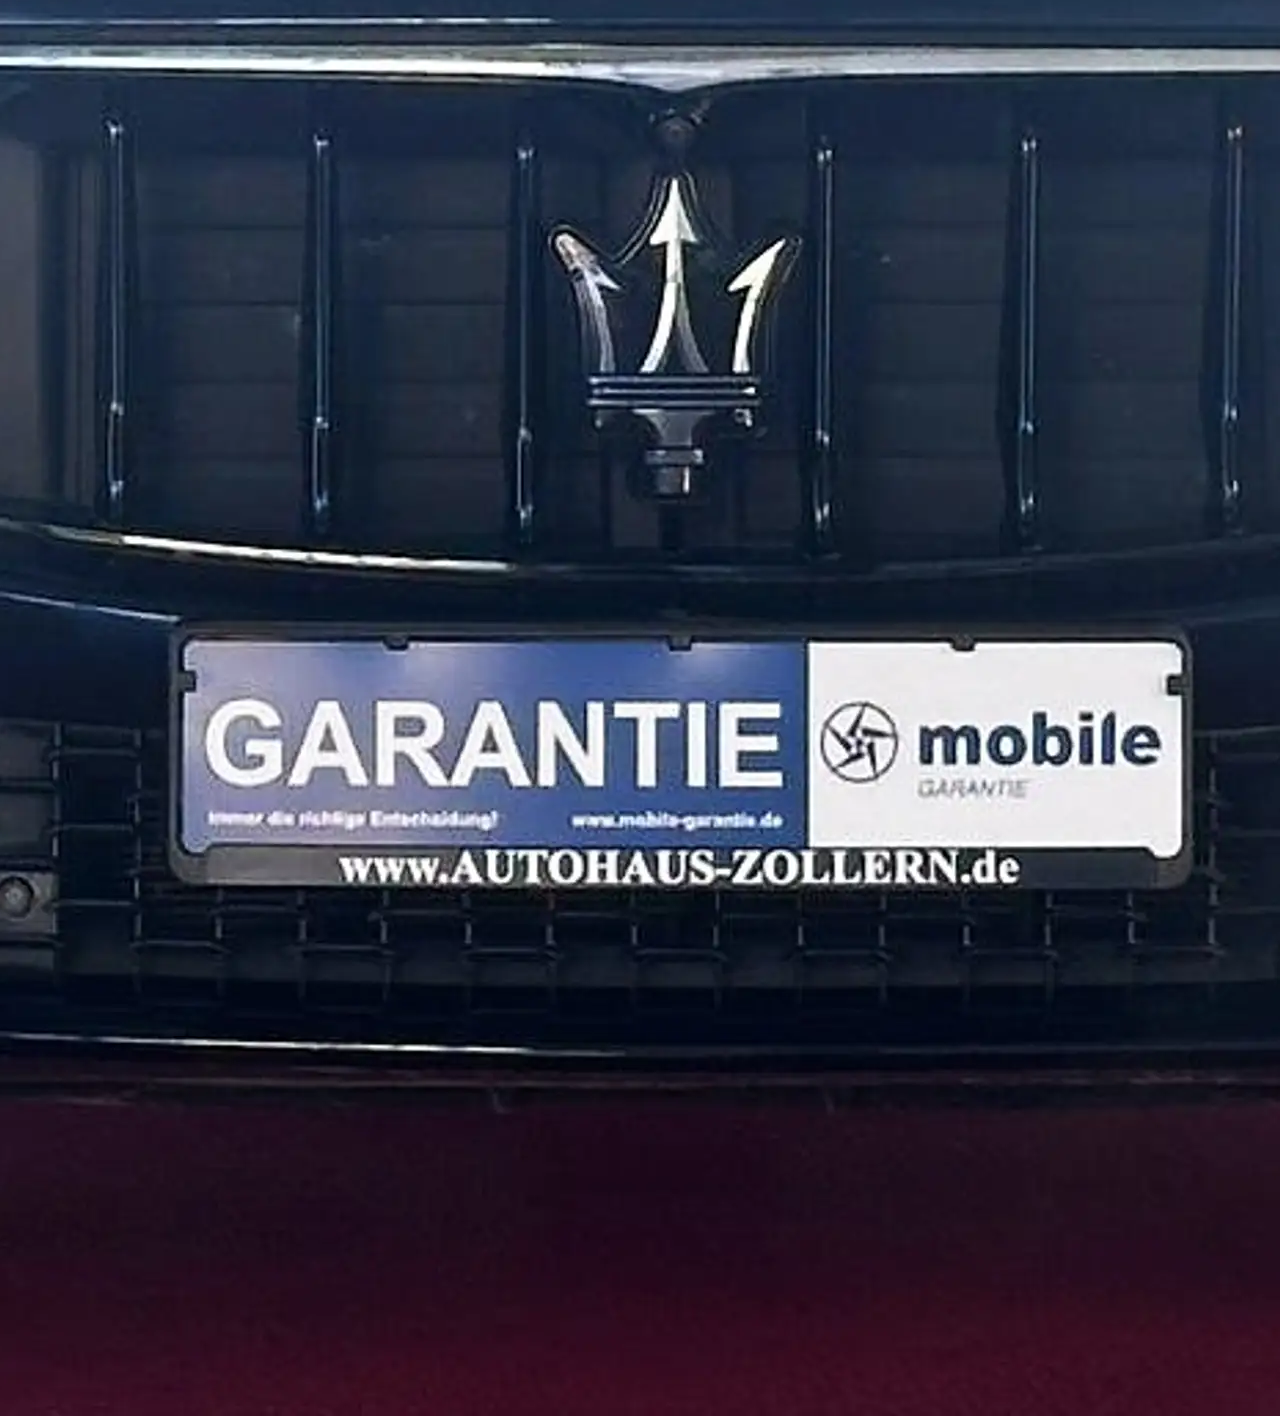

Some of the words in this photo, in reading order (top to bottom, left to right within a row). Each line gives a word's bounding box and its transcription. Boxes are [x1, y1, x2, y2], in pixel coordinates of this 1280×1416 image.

[205, 699, 783, 788] GARANTIE
[920, 711, 1161, 766] mobile
[920, 781, 1028, 798] GARANTIE
[571, 810, 784, 832] www.mobile-garantie.de
[338, 848, 1020, 885] www.AUTOHAUS-ZOLLERN.de
